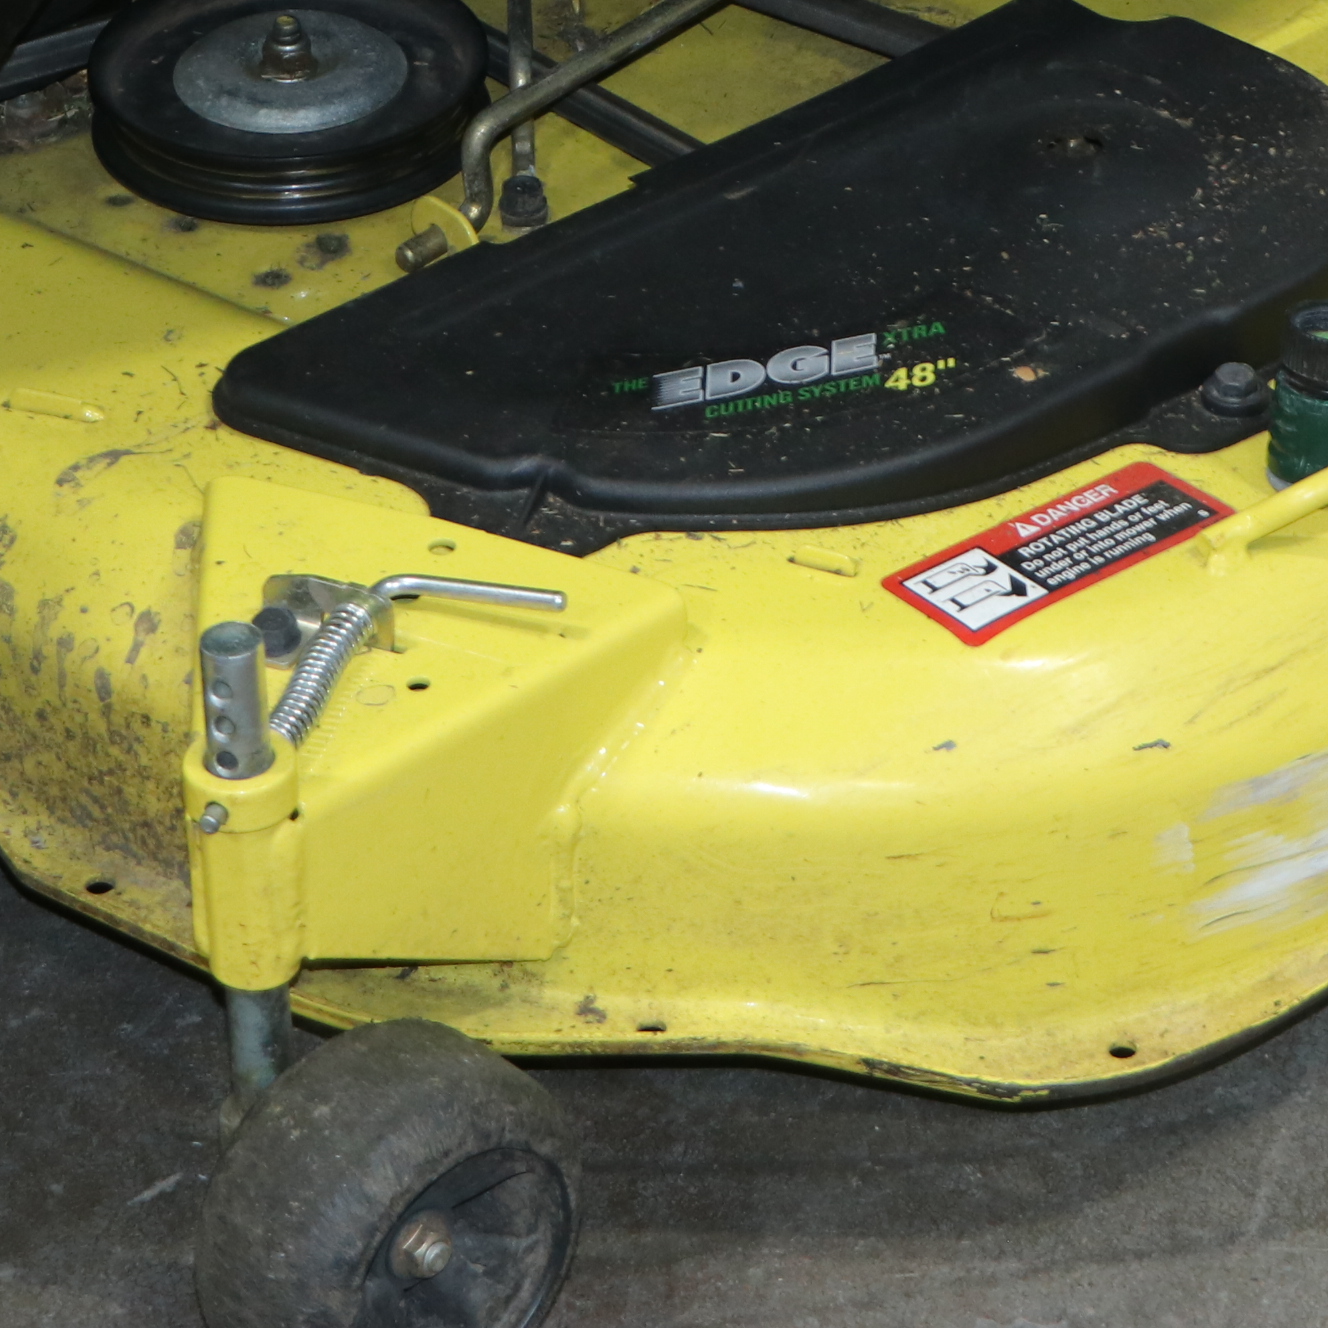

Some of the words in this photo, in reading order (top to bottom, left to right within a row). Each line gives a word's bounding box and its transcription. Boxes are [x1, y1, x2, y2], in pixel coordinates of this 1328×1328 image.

[882, 321, 946, 346] XTRA
[612, 377, 649, 394] THE
[651, 333, 878, 410] EDGE
[704, 391, 793, 418] CUTTING
[797, 374, 881, 400] SYSTEM
[884, 357, 957, 391] 48"
[1017, 518, 1098, 558] ROTATING
[1093, 494, 1149, 522] BLADE
[1020, 558, 1044, 571] Do
[1042, 547, 1068, 561] not
[1065, 536, 1091, 552] put
[1085, 519, 1129, 541] hands
[1127, 511, 1144, 522] or
[1140, 499, 1170, 515] feet
[1030, 484, 1118, 526] DANGER
[1034, 557, 1073, 578] under
[1072, 549, 1089, 560] or
[1085, 538, 1116, 553] into
[1114, 518, 1157, 541] mower
[1156, 502, 1193, 521] when
[1046, 562, 1091, 585] engine
[1087, 555, 1105, 565] is
[1104, 532, 1156, 558] running
